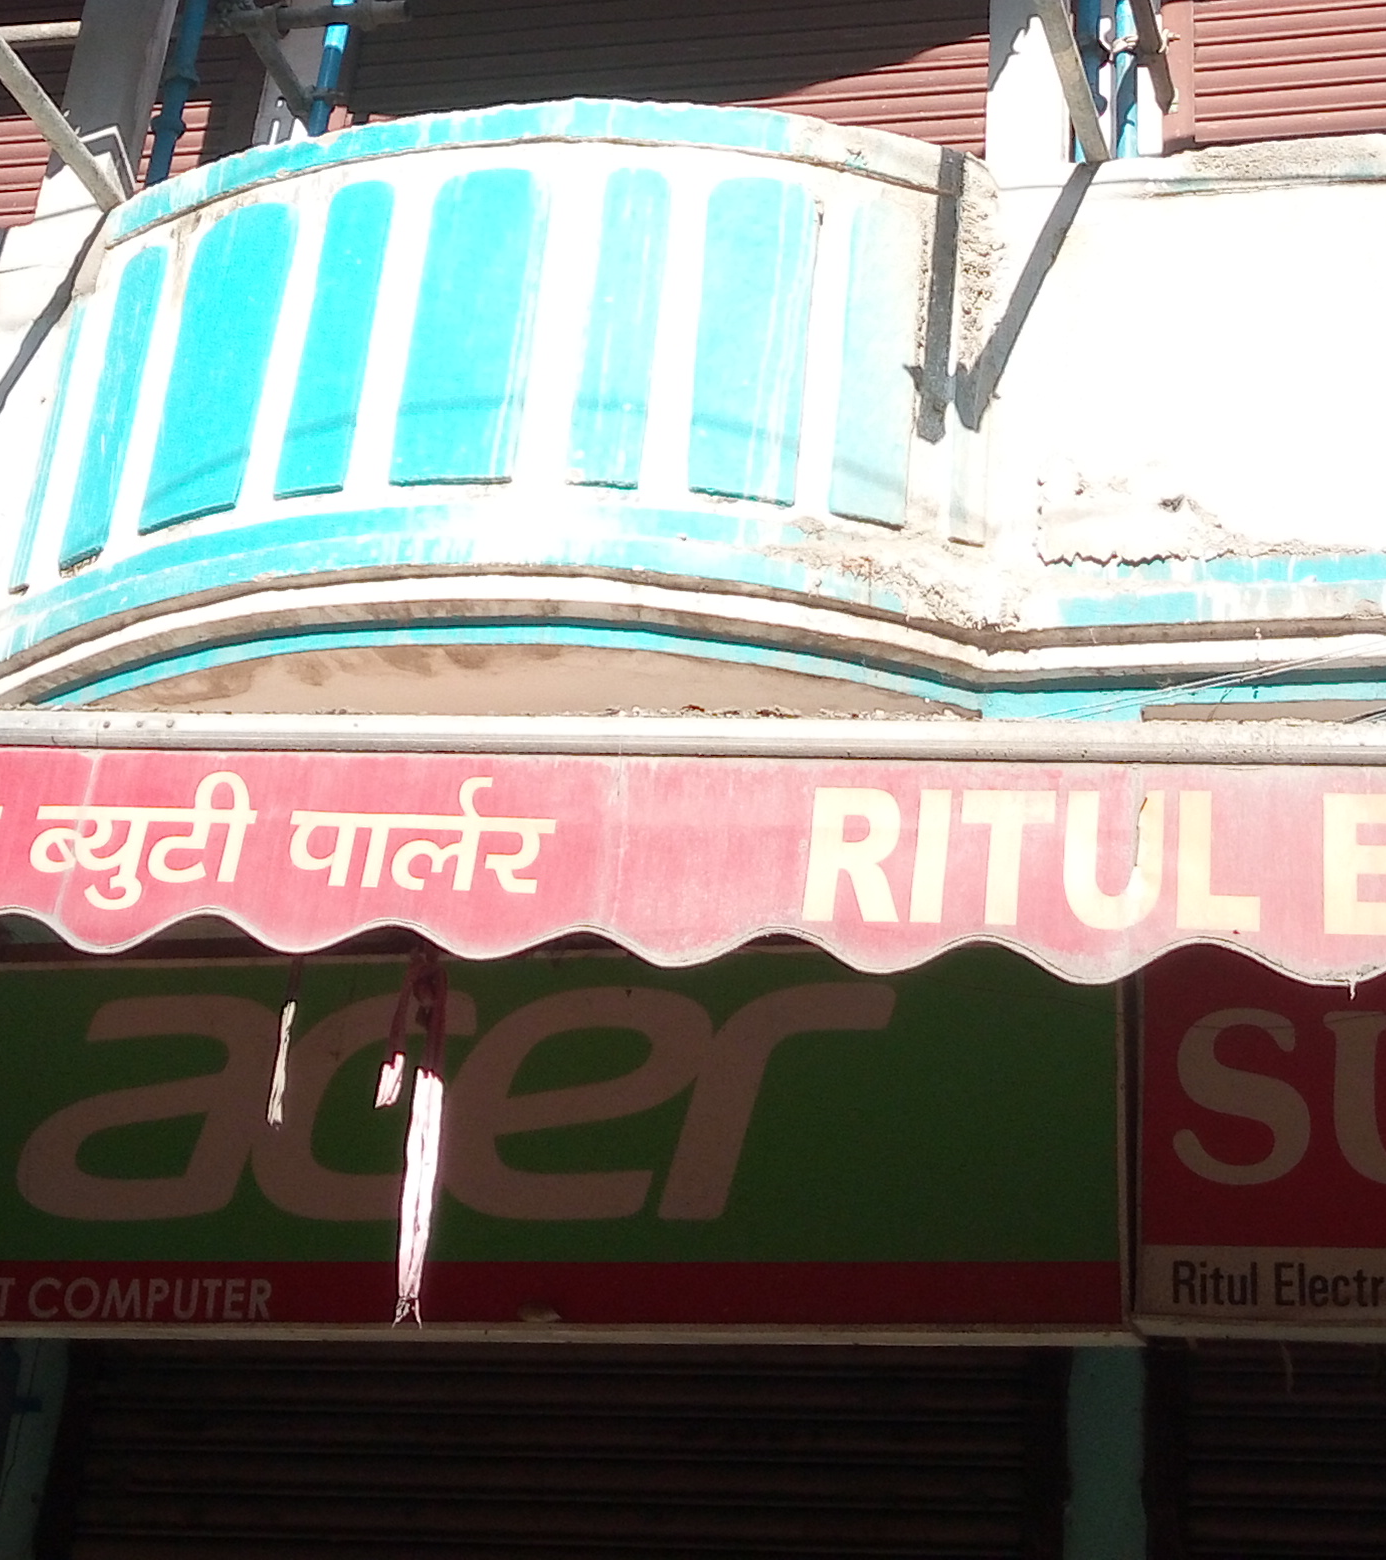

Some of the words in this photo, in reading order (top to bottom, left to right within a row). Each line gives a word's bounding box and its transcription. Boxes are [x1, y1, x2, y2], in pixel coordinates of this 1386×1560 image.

[28, 770, 258, 911] ब्युटी
[289, 775, 557, 895] पार्लर
[800, 787, 1262, 933] RITUL
[16, 982, 897, 1222] acer
[27, 1276, 273, 1321] COMPUTER
[1170, 1258, 1259, 1308] Ritul
